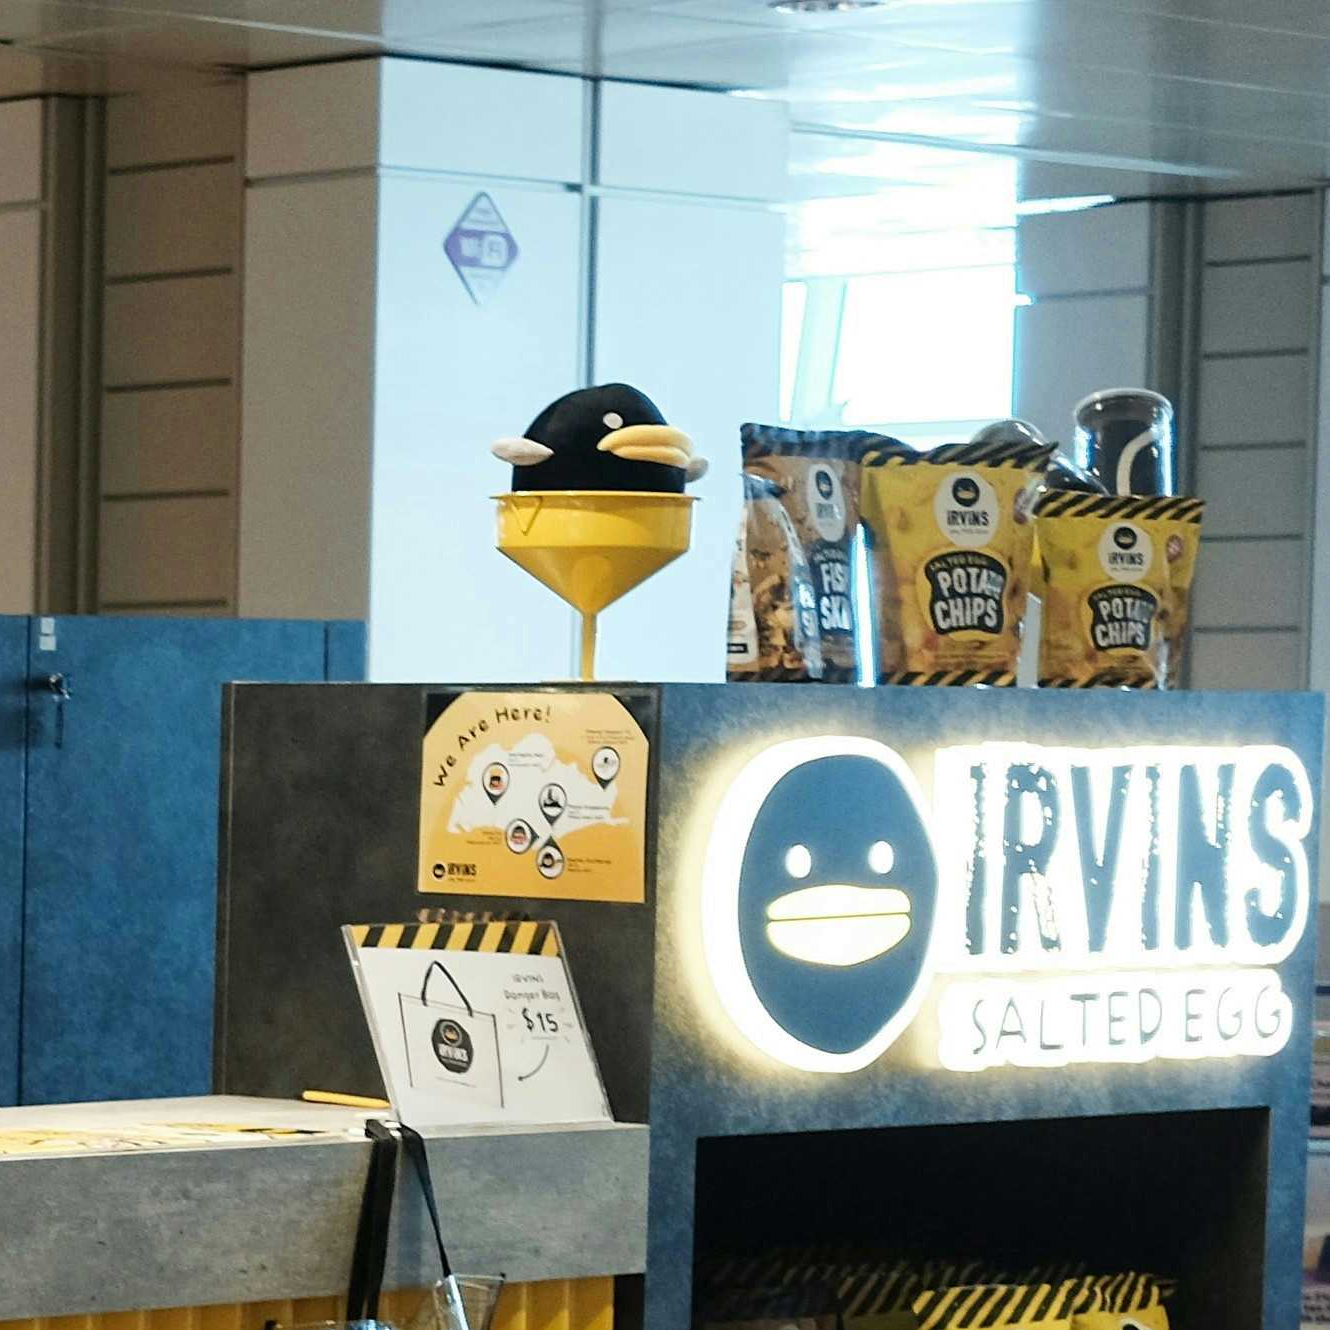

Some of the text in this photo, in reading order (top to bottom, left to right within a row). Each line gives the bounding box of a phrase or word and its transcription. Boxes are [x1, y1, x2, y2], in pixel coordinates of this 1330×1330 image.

[947, 510, 990, 526] IRVINS
[820, 563, 850, 595] FIS
[934, 597, 998, 630] CHIPS
[1099, 597, 1154, 624] POT
[1095, 621, 1146, 647] CHIPS
[433, 705, 552, 787] We Are Here!
[965, 762, 1303, 955] IRVINS
[970, 986, 1283, 1056] SALTED EGG
